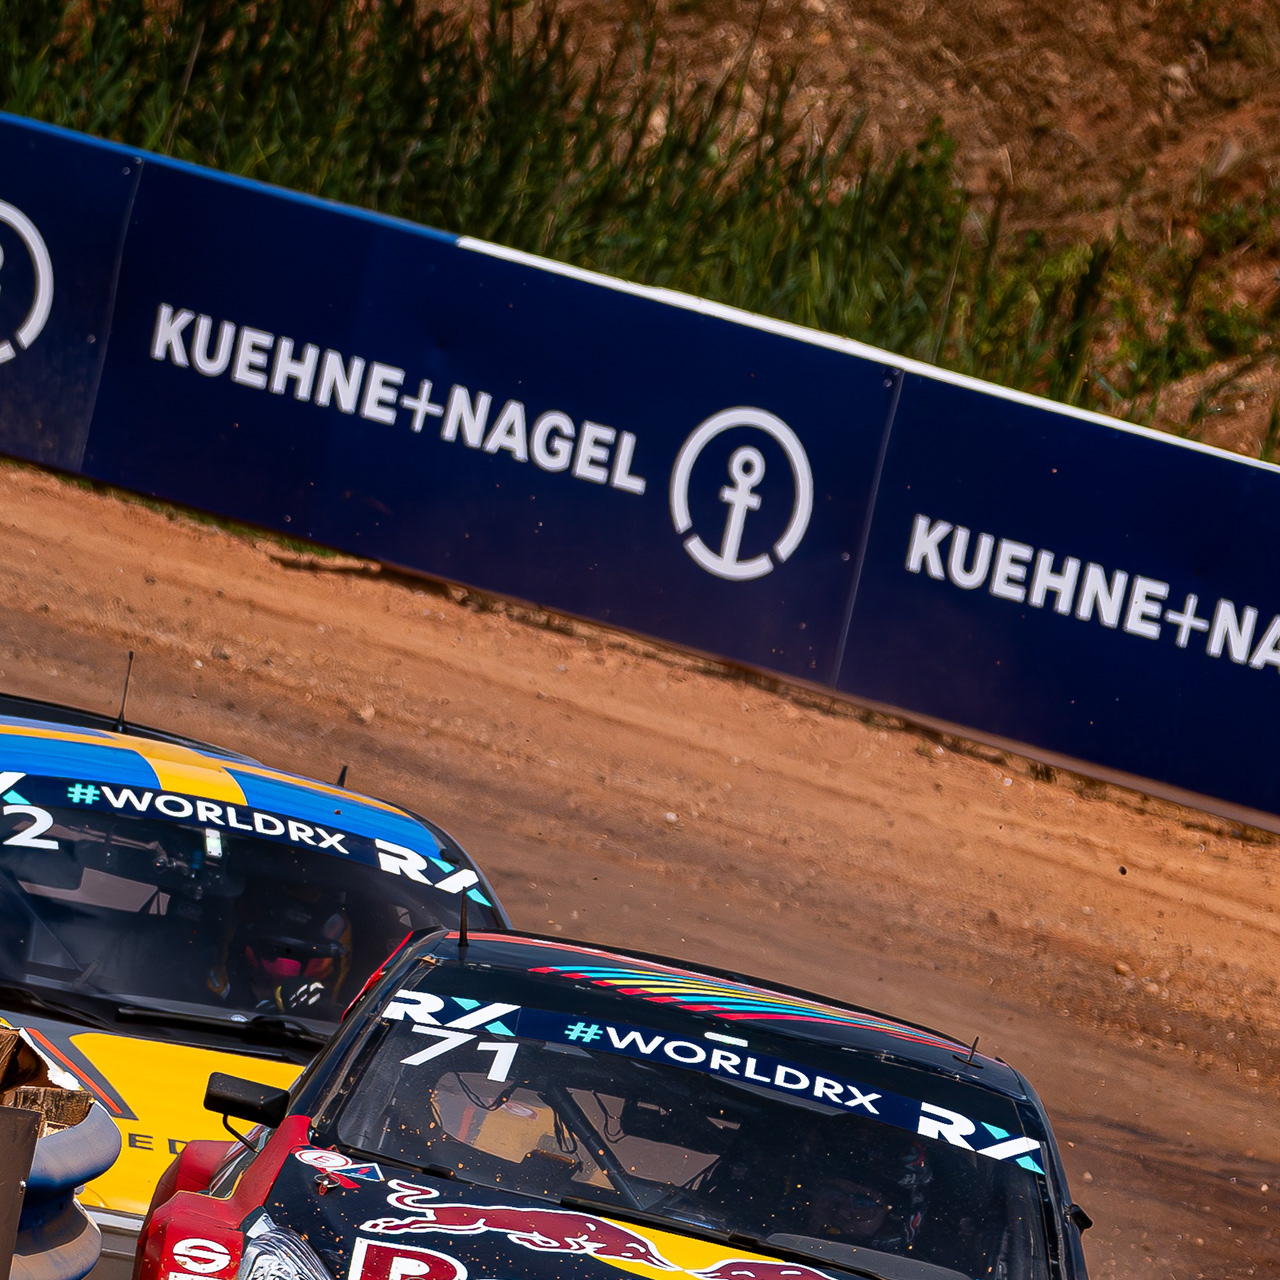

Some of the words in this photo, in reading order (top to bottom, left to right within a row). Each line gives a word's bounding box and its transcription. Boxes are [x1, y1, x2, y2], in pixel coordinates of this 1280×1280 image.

[151, 303, 645, 494] KUEHNE+NAGEL
[67, 783, 350, 855] #WORLDRX
[381, 989, 521, 1036] RX
[399, 1024, 519, 1083] 71
[564, 1021, 882, 1115] #WORLDRX
[918, 1102, 1046, 1175] RX
